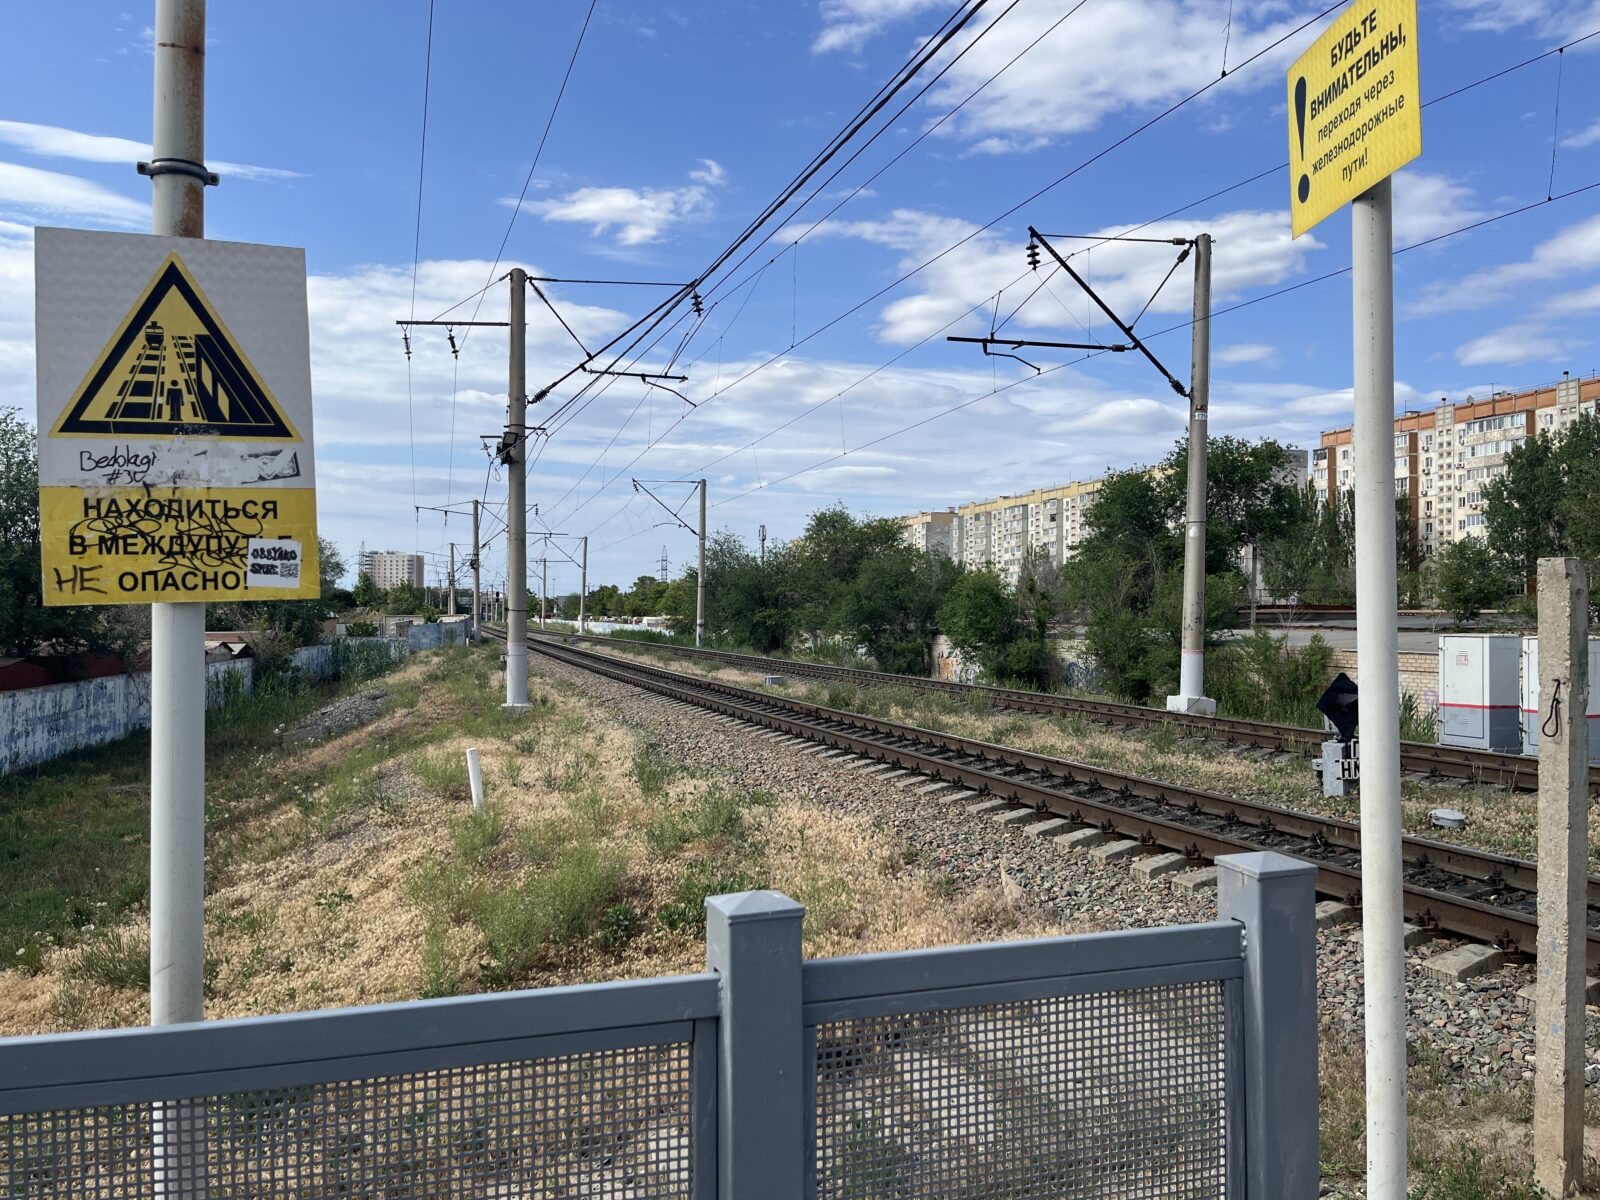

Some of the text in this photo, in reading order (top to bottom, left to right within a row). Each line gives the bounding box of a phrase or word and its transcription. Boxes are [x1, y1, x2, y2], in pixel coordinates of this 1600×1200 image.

[1331, 8, 1377, 68] БУДЬТЕ
[1310, 23, 1406, 120] ВНИМАТЕЛЬНЫ,
[1318, 69, 1395, 142] переходя через
[1312, 94, 1405, 175] железнодорожные
[1342, 147, 1368, 182] пути!
[83, 498, 278, 523] НАХОДИТЬСЯ
[69, 535, 87, 555] В
[53, 564, 108, 594] НЕ
[118, 571, 249, 592] ОПАСНО!
